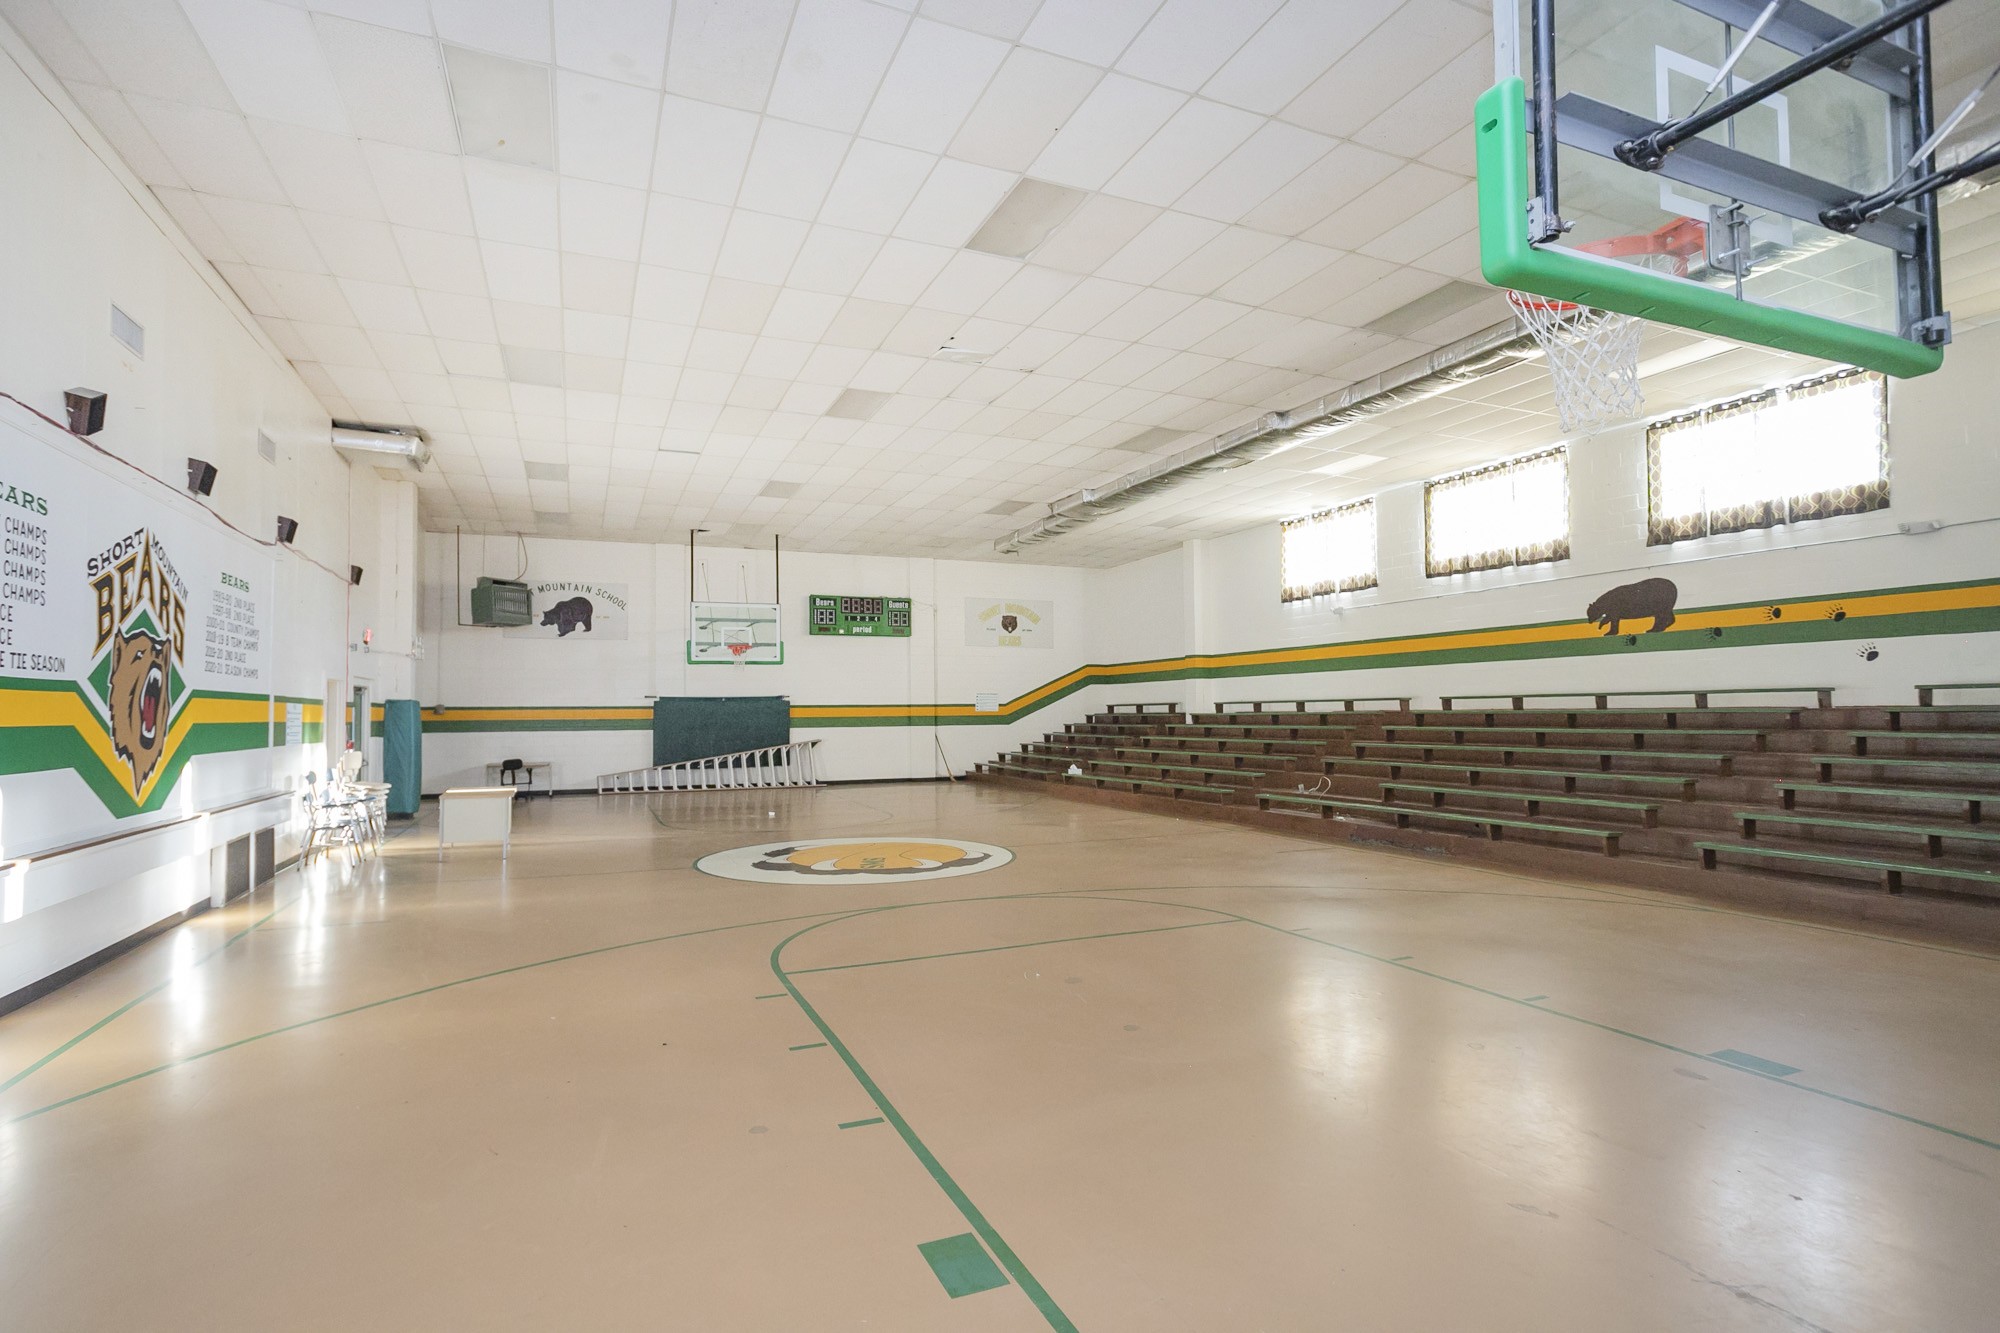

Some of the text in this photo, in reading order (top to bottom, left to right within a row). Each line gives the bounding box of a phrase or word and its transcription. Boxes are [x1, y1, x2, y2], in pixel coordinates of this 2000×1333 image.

[0, 481, 48, 516] ARS
[4, 516, 48, 545] CHAMPS
[4, 538, 47, 565] CHAMPS
[3, 560, 46, 586] CHAMPS
[87, 527, 189, 603] SHORT MOUNTAIN
[2, 582, 46, 606] CHAMPS
[221, 572, 250, 593] BEARS
[88, 526, 186, 668] BEARS
[537, 582, 593, 594] MOUNTAIN
[595, 588, 629, 611] SCHOOL
[815, 598, 835, 606] Bears
[888, 600, 909, 609] Guests
[230, 636, 242, 648] TEAM
[852, 626, 872, 634] period
[9, 652, 27, 669] TIE
[30, 654, 65, 672] SEASON
